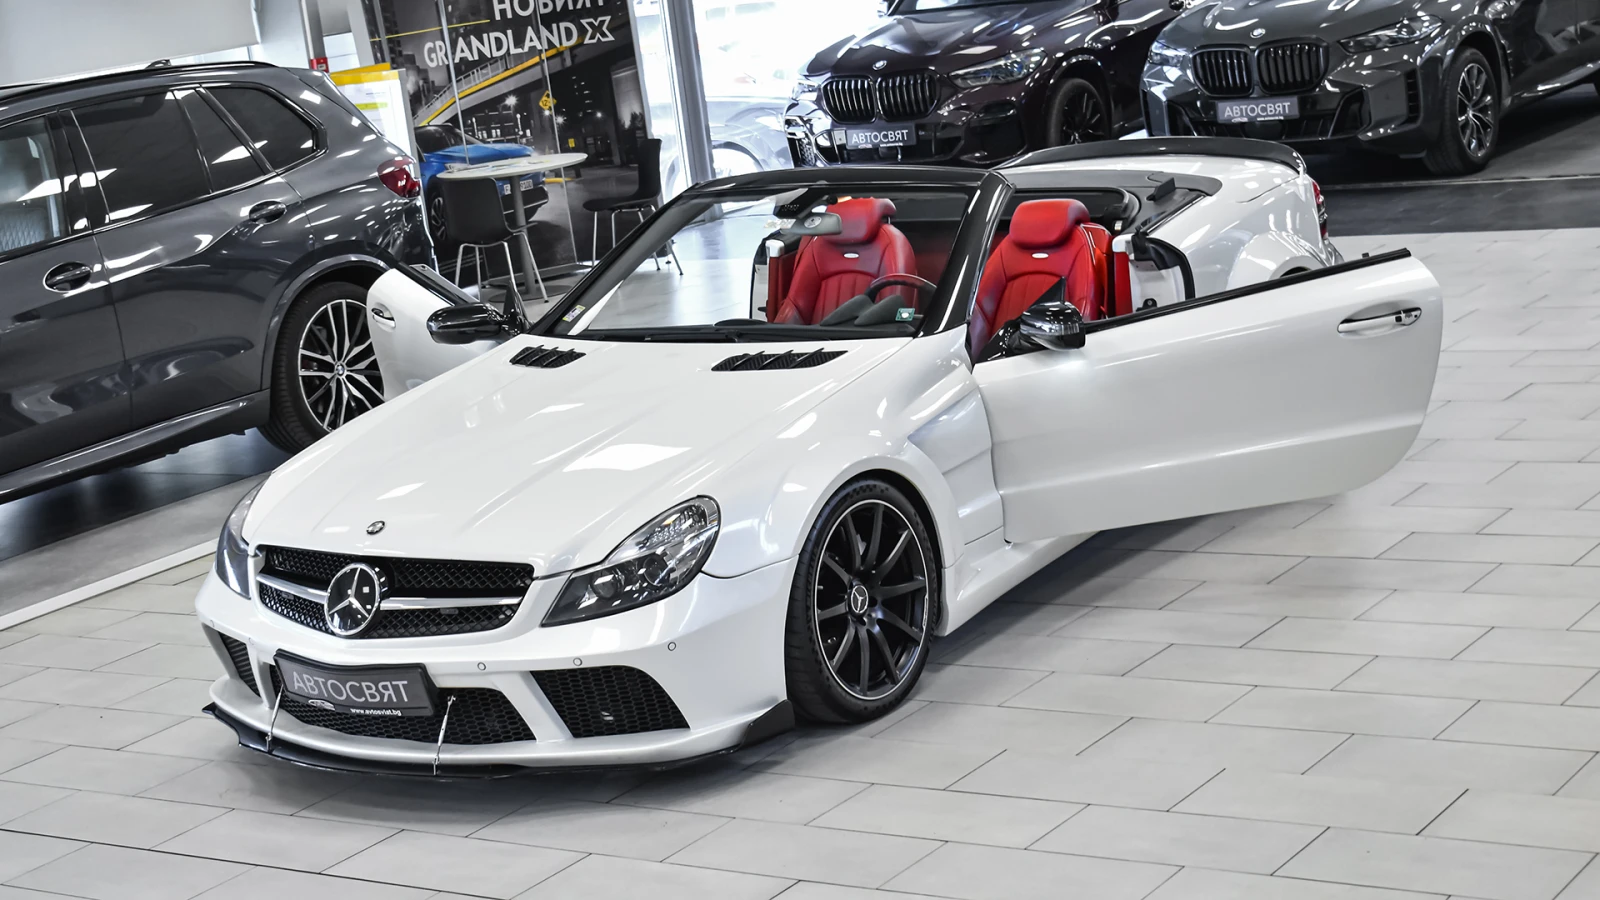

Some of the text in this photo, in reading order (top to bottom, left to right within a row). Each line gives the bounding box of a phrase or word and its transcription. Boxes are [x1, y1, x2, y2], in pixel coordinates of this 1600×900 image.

[423, 16, 616, 68] GRANDLAND X
[1224, 102, 1291, 118] АВТОСВЯТ
[851, 129, 909, 144] АВТОСВЯТ
[292, 671, 409, 703] АВТОСВЯТ
